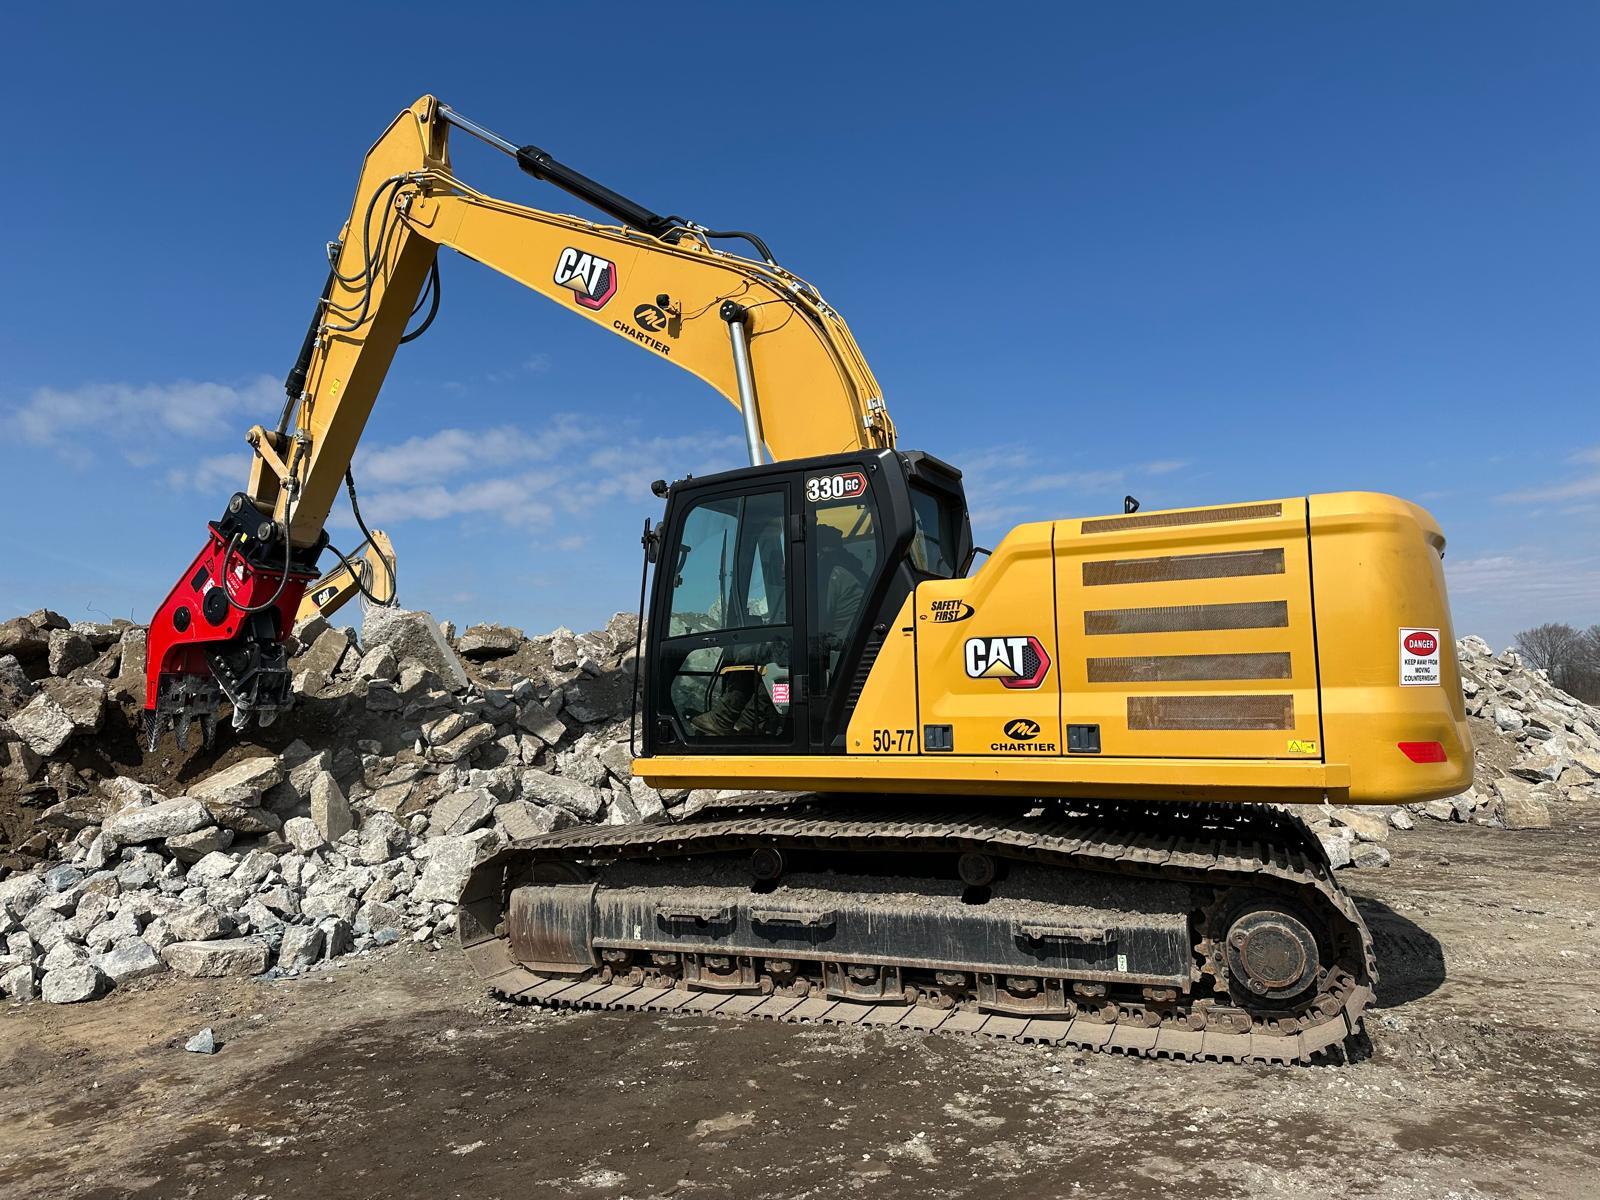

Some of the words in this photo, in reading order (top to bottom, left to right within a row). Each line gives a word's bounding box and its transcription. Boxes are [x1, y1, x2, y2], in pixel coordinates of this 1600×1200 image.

[555, 247, 609, 296] CAT
[613, 320, 671, 355] CHARTIER
[931, 600, 962, 611] SAFETY
[935, 611, 960, 621] FIRST
[1409, 640, 1434, 649] DANGER
[965, 637, 1028, 677] CAT
[873, 729, 914, 752] 50-77
[990, 743, 1056, 751] CHARTIER
